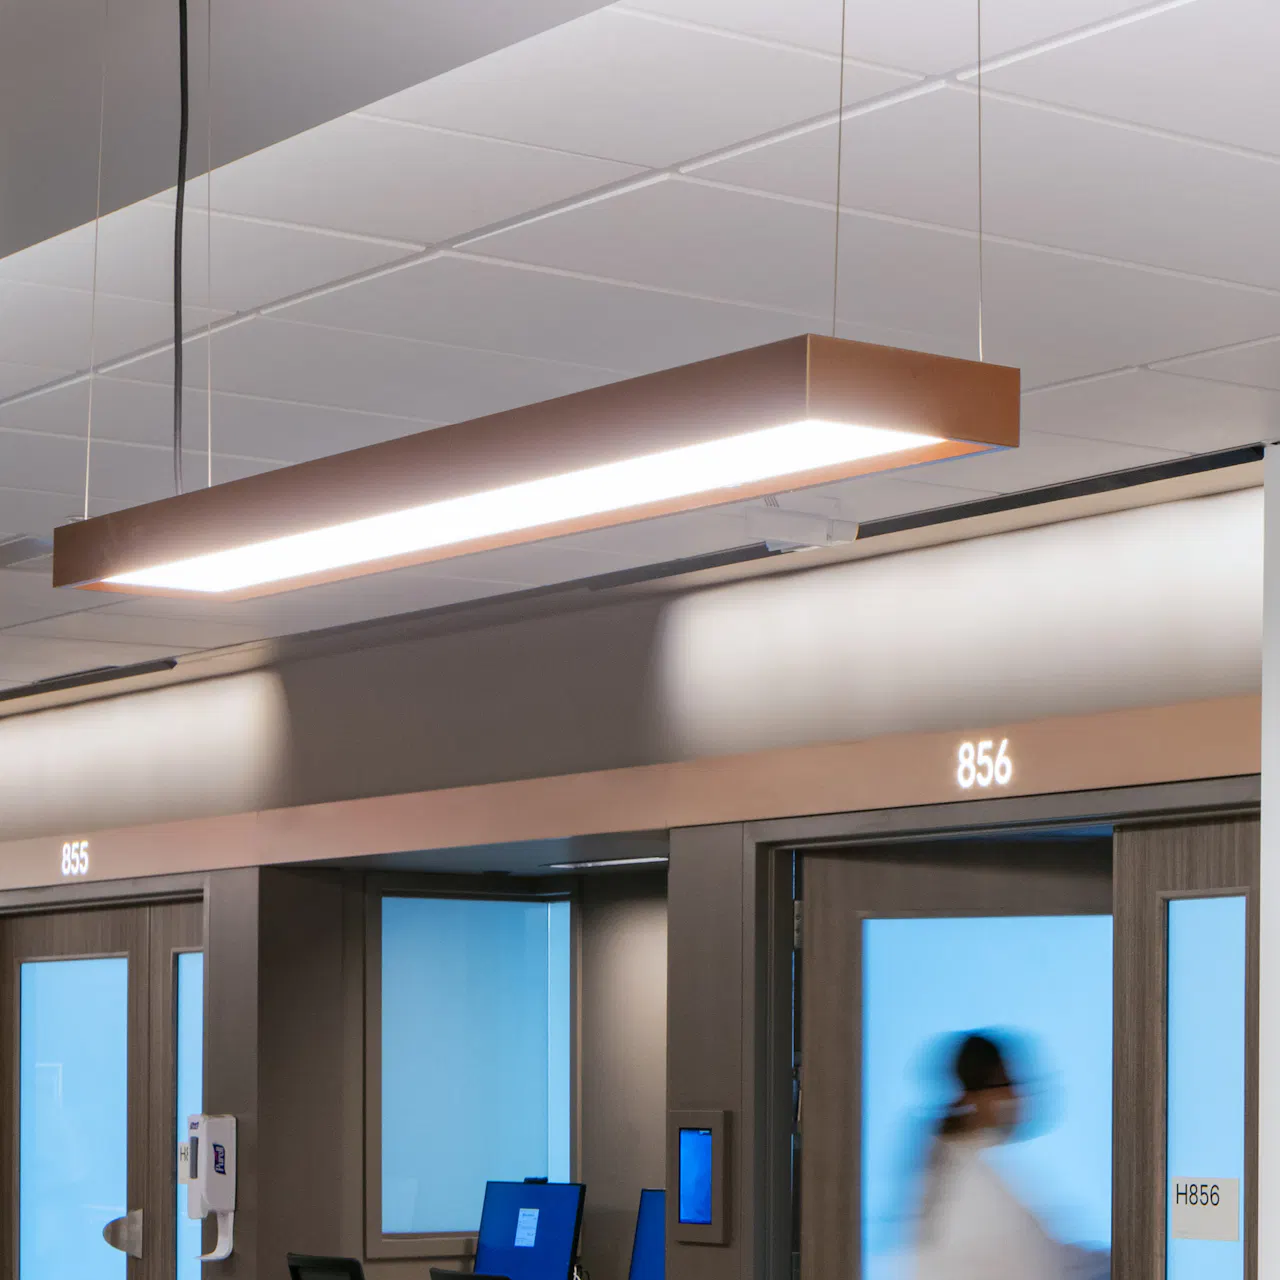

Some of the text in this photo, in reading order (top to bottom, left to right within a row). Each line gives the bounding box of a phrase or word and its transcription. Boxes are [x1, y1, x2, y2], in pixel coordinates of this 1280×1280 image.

[957, 738, 1013, 789] 856
[62, 841, 89, 876] 855
[1176, 1183, 1220, 1206] H856
